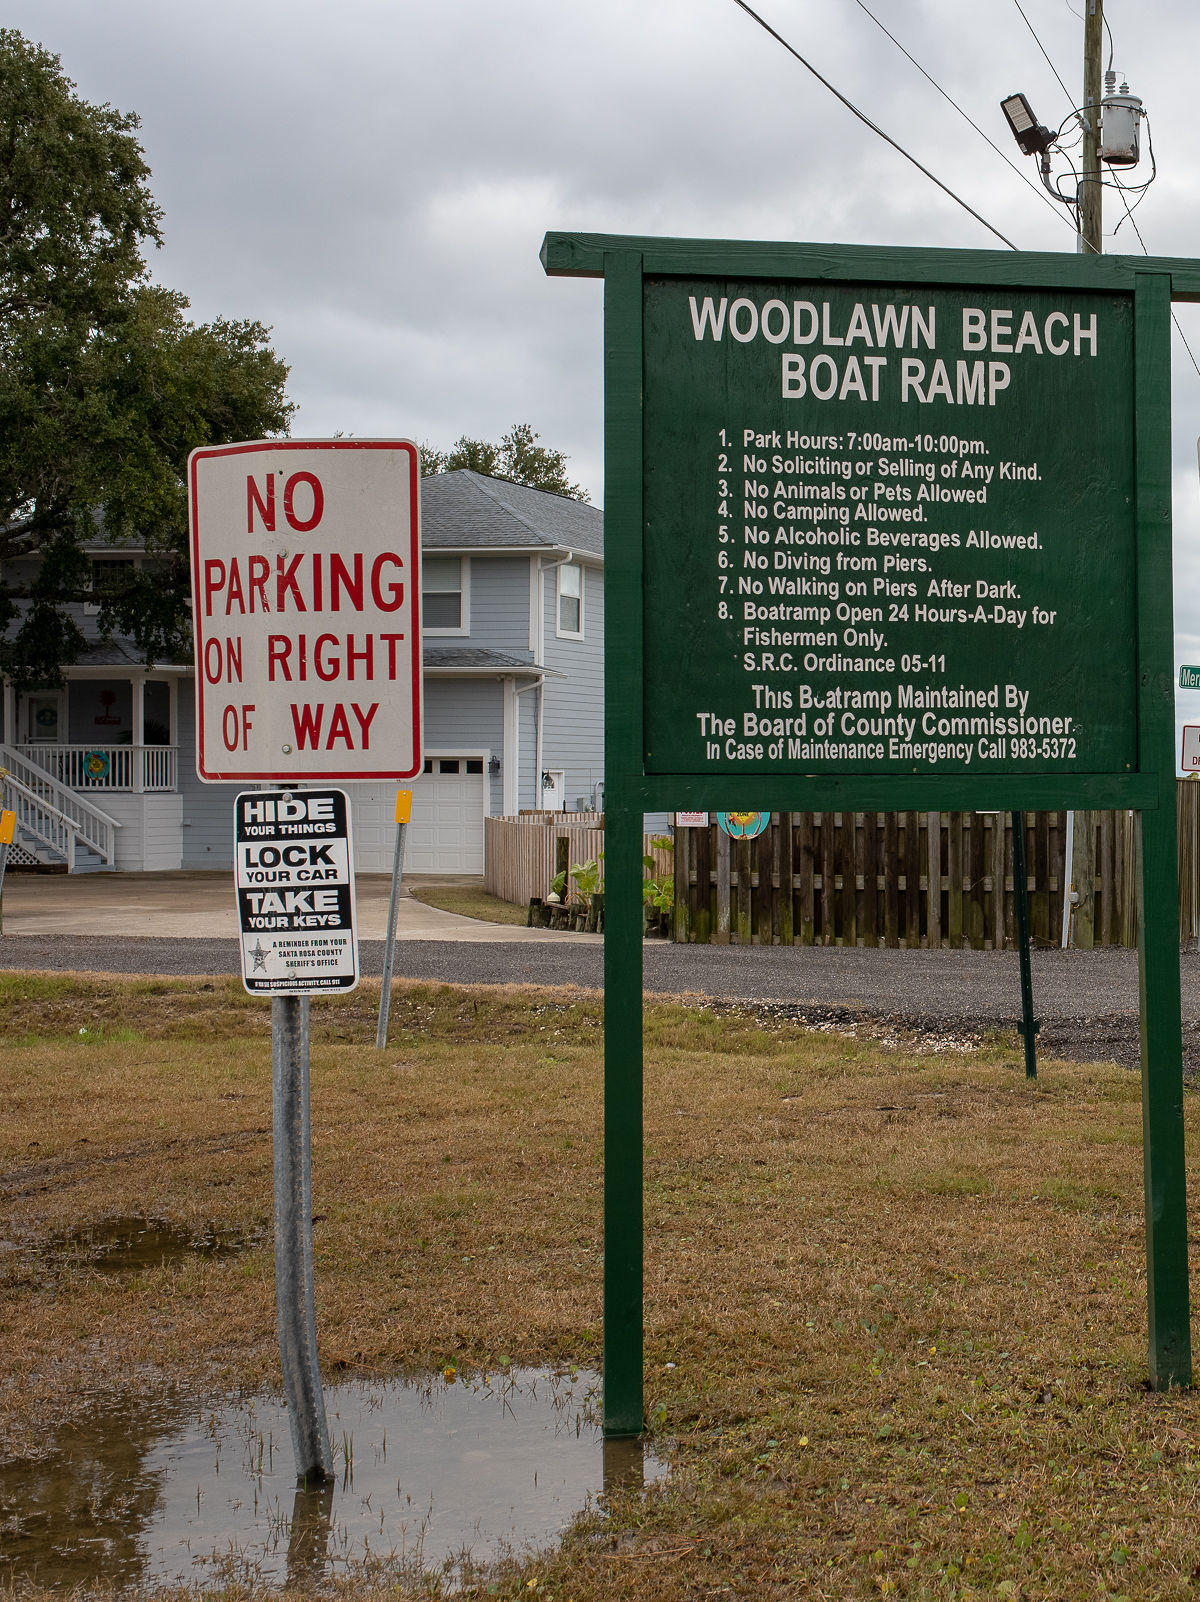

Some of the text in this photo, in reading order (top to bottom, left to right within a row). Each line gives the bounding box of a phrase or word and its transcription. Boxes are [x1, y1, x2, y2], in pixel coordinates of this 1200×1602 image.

[689, 296, 1098, 357] WOODLAWN BEACH
[781, 353, 1011, 406] BOAT RAMP
[718, 429, 990, 458] 1. Park Hours: 7:00am-10:00pm.
[718, 454, 1042, 483] 2. No Soliciting or Selling of Any Kind.
[247, 471, 324, 533] NO
[718, 479, 987, 504] 3. No Animals or Pets Allowed
[718, 500, 928, 525] 4. No Camping Allowed.
[718, 525, 1043, 552] 5. No Alcoholic Beverages Allowed.
[718, 551, 932, 574] 6. No Diving from Piers.
[204, 552, 404, 617] PARKING
[718, 576, 1021, 600] 7. No Walking on Piers After Dark.
[718, 602, 1057, 629] 8. Boatramp Open 24 Hours-A-Day for
[743, 627, 888, 651] Fishermen Only.
[204, 633, 404, 685] ON RIGHT
[743, 652, 946, 673] S.R.C. Ordinance 05-11
[752, 684, 793, 709] This
[898, 684, 999, 709] Maintained
[1005, 684, 1030, 715] By
[222, 702, 379, 752] OF WAY
[696, 711, 1078, 741] The Board of County Commissioner
[706, 737, 1077, 764] In Case of Maintenance Emergency Call 983-5372
[244, 797, 335, 823] HIDE
[244, 822, 337, 836] YOUR THINGS
[245, 843, 336, 869] LOCK
[246, 868, 338, 883] YOUR CAR
[246, 889, 339, 914] TAKE
[248, 914, 342, 929] YOUR KEYS
[278, 940, 309, 948] REMINDER
[310, 939, 329, 947] FROM
[330, 938, 347, 946] YOUR
[278, 948, 343, 958] SANTA ROSA COUNTY
[285, 958, 339, 968] SHERIFF'S OFFICE
